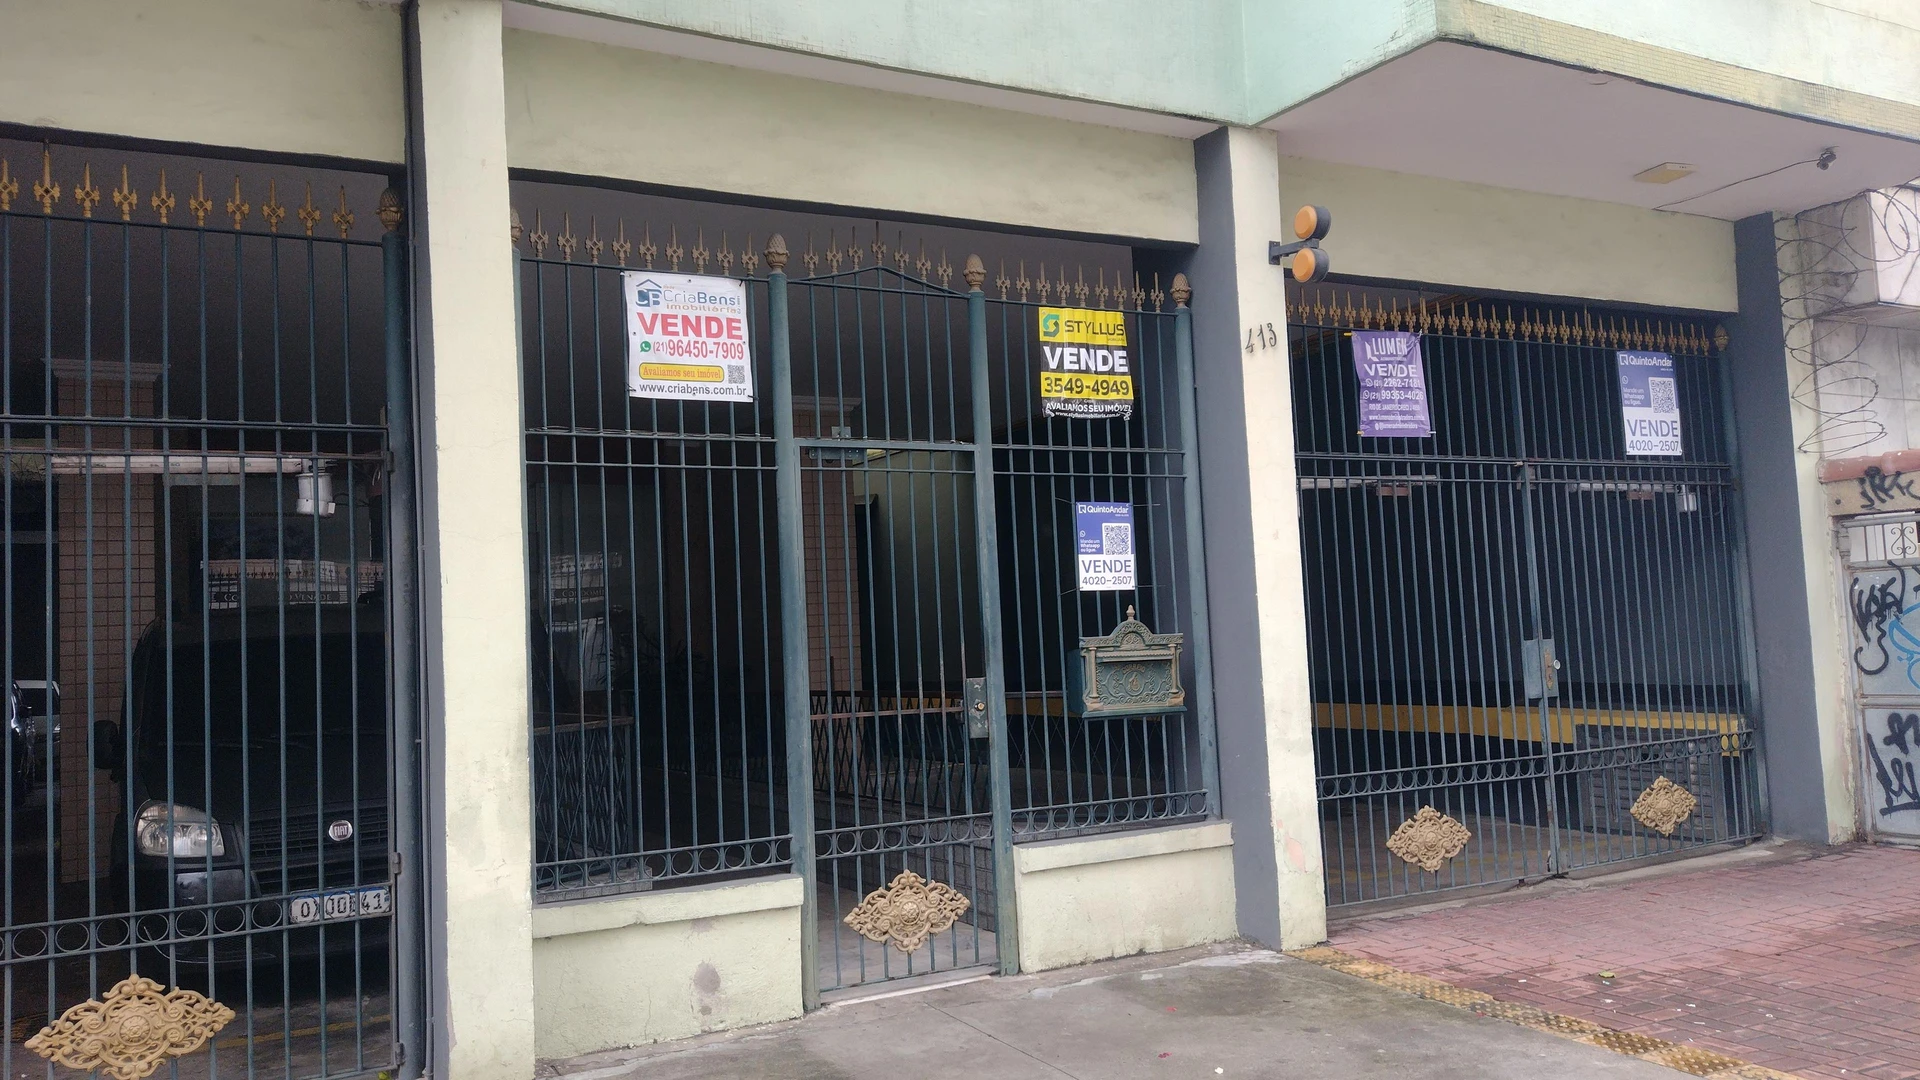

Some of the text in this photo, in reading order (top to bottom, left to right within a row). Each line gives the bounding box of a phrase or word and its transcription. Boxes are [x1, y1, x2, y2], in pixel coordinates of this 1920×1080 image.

[664, 289, 736, 306] CriaBens
[666, 303, 737, 314] imobiliária
[637, 312, 743, 340] VENDE
[1064, 320, 1125, 336] STYLLUS
[1245, 322, 1277, 353] 413
[1043, 346, 1129, 373] VENDE
[1628, 355, 1673, 367] QuintoAndar
[643, 366, 721, 379] Avaliamos seu imóvel
[1364, 363, 1418, 378] VENDE
[639, 383, 747, 395] www.criabens.com.br
[1044, 376, 1130, 396] 3549-4949
[1088, 404, 1104, 413] SEU
[1627, 419, 1679, 437] VENDE
[1629, 440, 1679, 452] 4020-2507
[1087, 505, 1129, 514] QuintoAndar
[1081, 559, 1132, 573] VENDE
[1082, 576, 1132, 586] 4020-2507
[333, 825, 348, 837] FIAT
